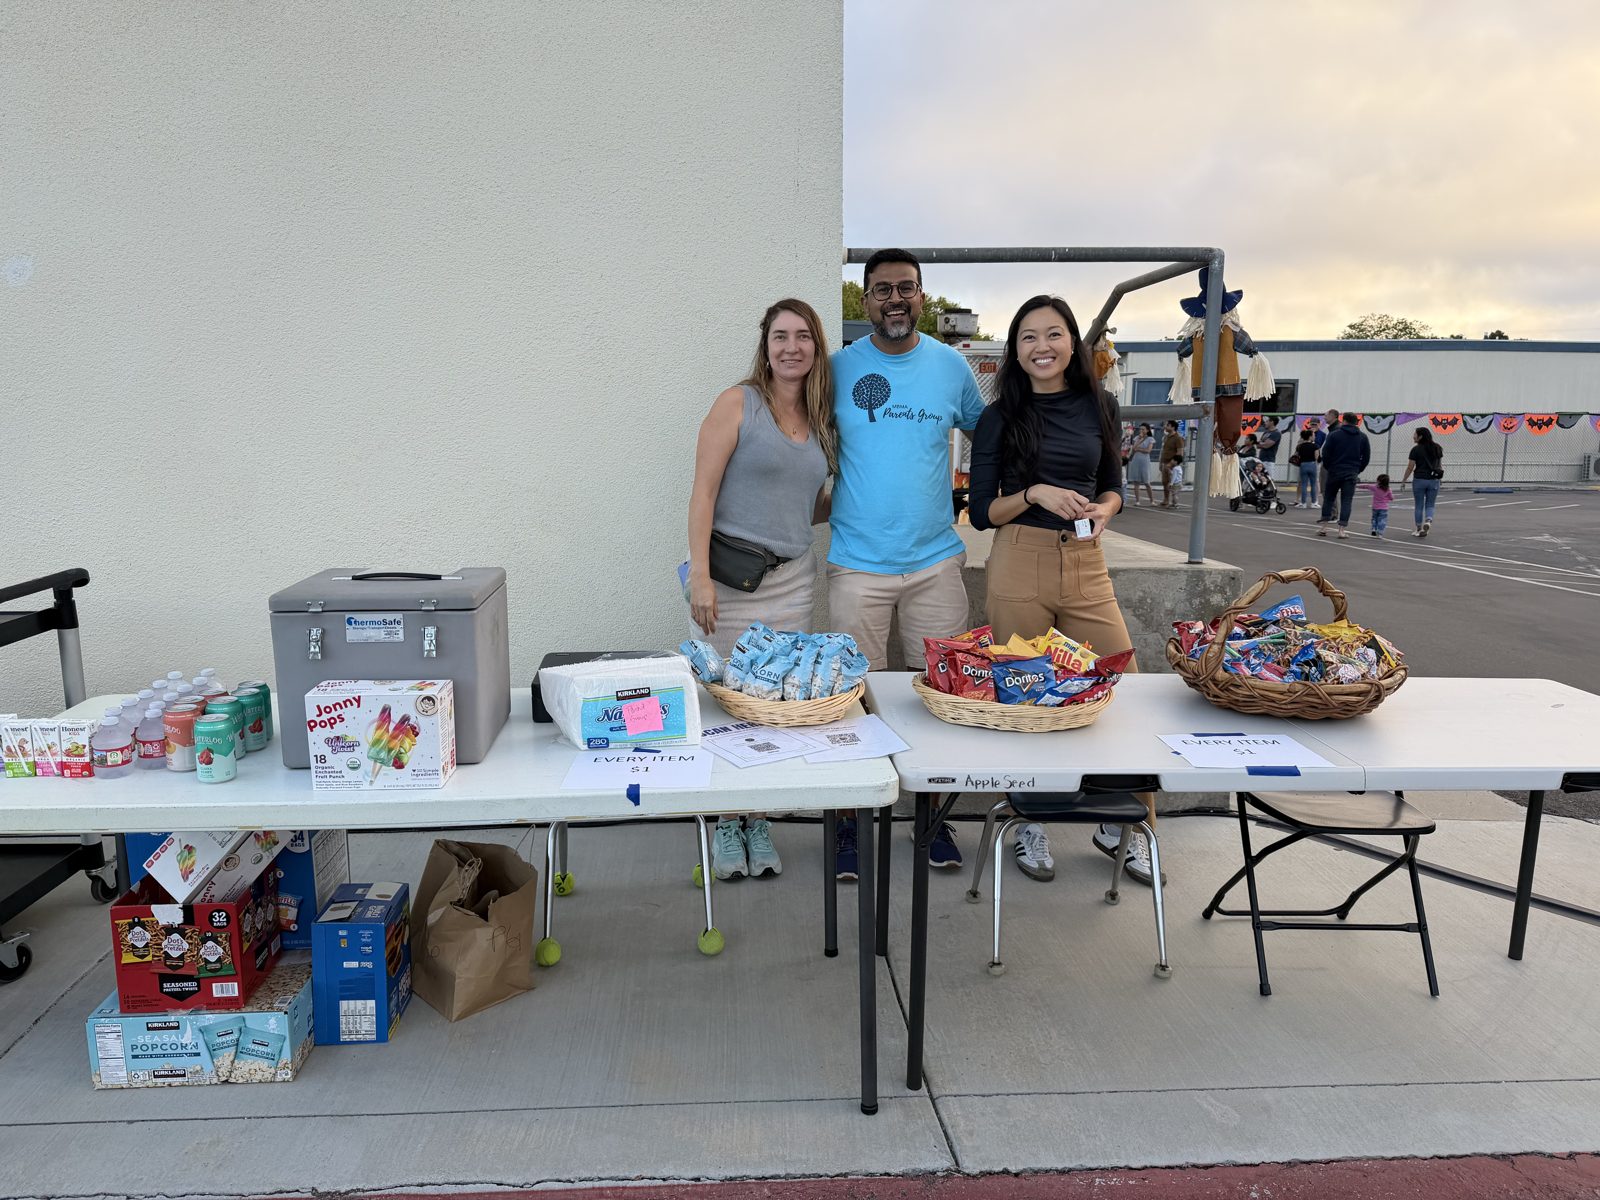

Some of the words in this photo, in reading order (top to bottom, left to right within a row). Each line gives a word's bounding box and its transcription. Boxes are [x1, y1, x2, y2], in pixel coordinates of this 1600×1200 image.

[981, 363, 995, 372] EXIT
[883, 408, 916, 420] Parents
[918, 408, 944, 424] Group
[346, 617, 402, 626] ThermoSafe
[1063, 641, 1079, 654] mini
[1044, 645, 1083, 672] Nilla
[1005, 672, 1045, 688] Doritos
[617, 688, 650, 698] KIRKLAND
[316, 695, 361, 718] Jonny
[313, 754, 327, 764] 18
[965, 774, 1000, 790] Apple
[1003, 774, 1035, 790] Seed
[212, 911, 227, 922] 32
[167, 936, 184, 944] Dot's
[163, 981, 198, 989] SEASONED
[137, 1035, 161, 1043] SEA
[130, 1042, 199, 1053] POPCORN
[240, 1046, 276, 1058] POPCORN
